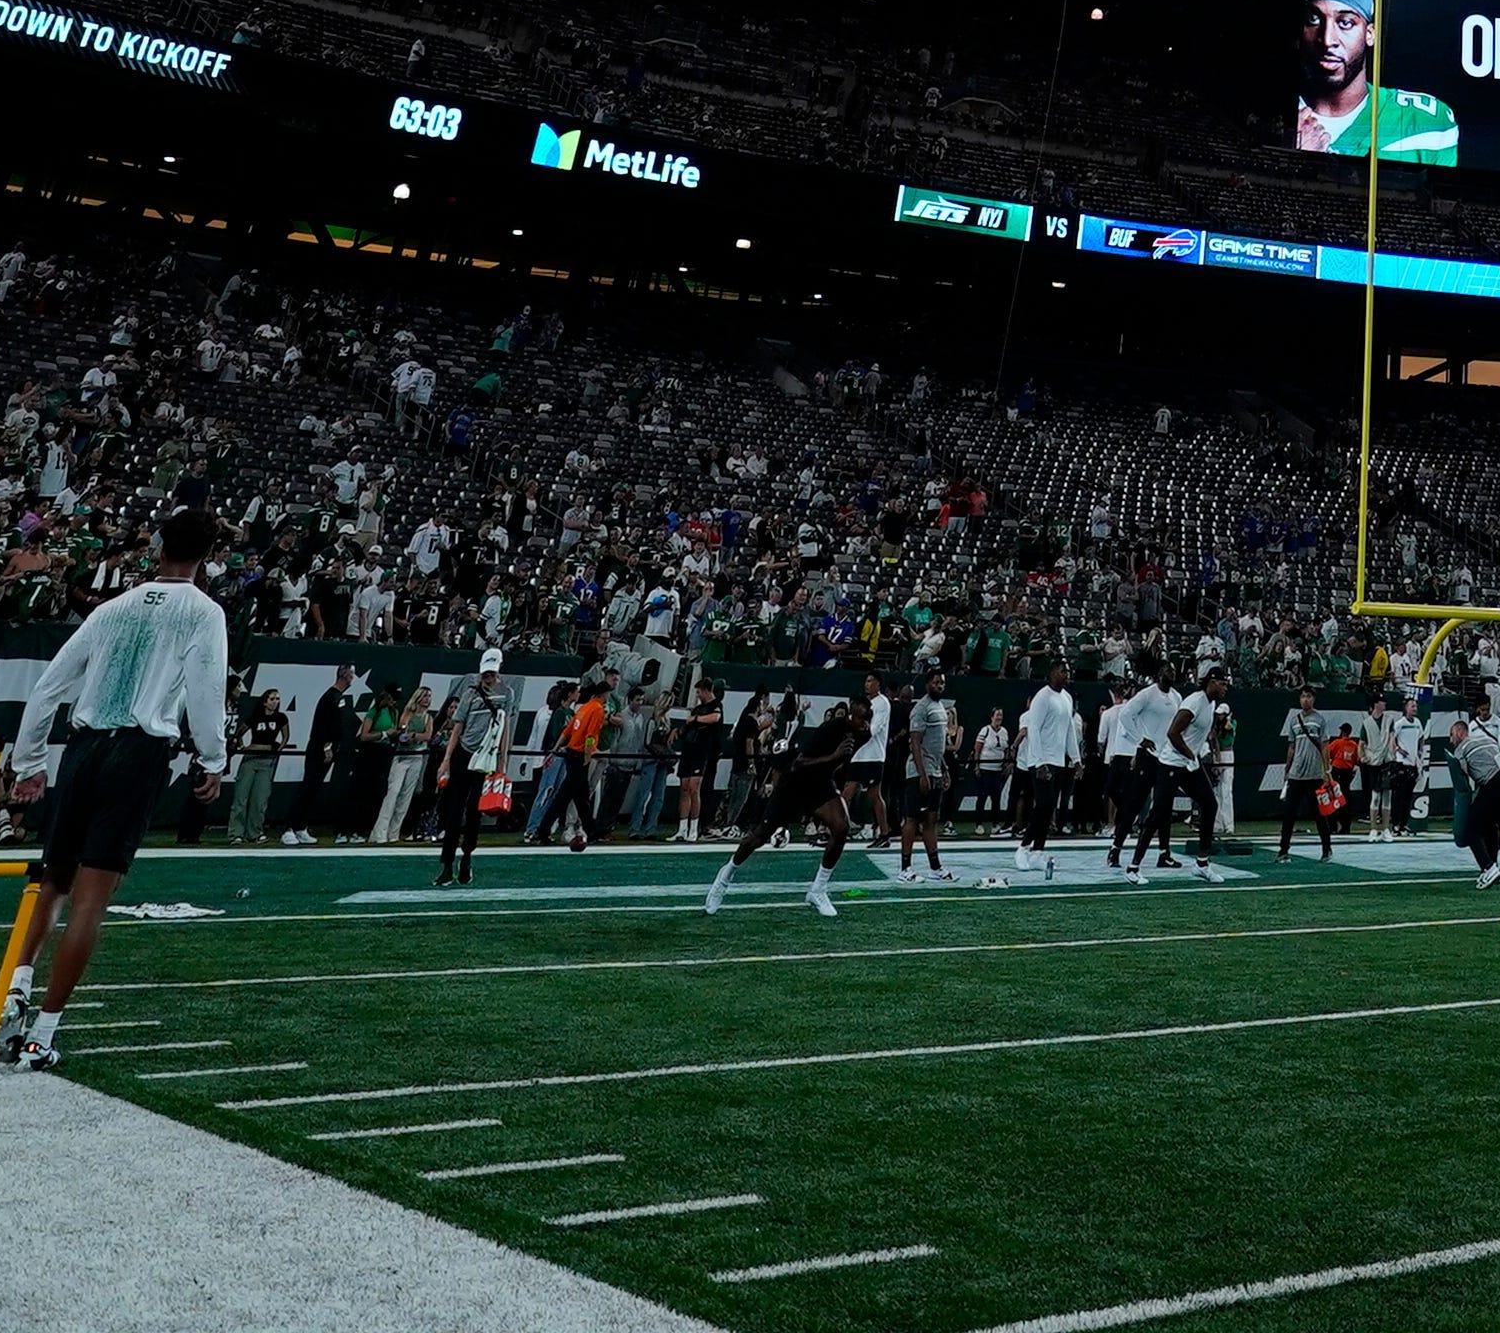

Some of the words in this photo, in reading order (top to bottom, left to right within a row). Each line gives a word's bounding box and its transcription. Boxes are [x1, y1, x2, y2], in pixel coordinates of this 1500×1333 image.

[79, 21, 115, 52] TO
[117, 31, 232, 78] KICKOFF
[389, 96, 462, 141] 63:03
[583, 139, 701, 188] MetLife
[902, 196, 971, 224] JETS
[976, 206, 1006, 230] NYJ
[1045, 214, 1070, 239] VS
[1106, 226, 1138, 249] BUF
[1208, 237, 1264, 257] GAME
[1265, 244, 1313, 263] TIME
[143, 591, 168, 606] 55
